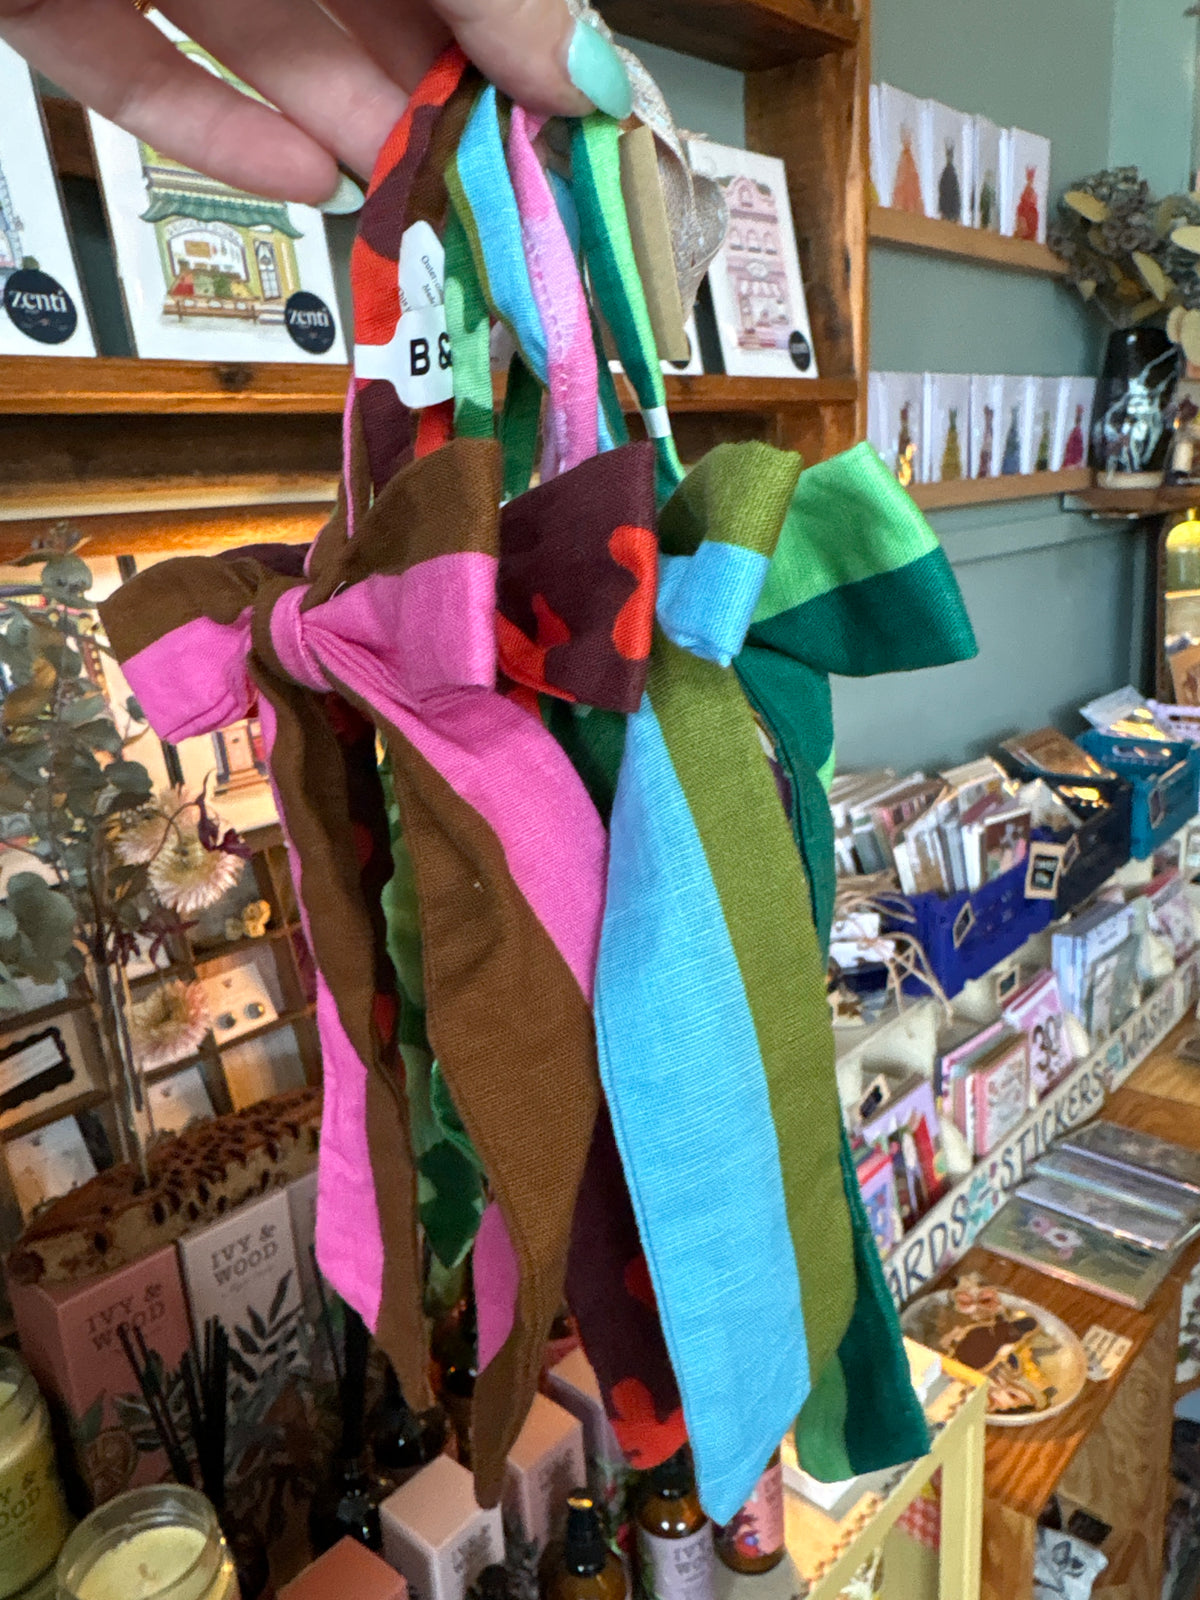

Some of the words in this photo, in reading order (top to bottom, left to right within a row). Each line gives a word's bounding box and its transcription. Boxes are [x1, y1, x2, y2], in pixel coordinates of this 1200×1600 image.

[409, 338, 431, 376] B
[438, 332, 452, 370] &
[888, 1194, 968, 1302] ARDS
[1000, 1059, 1103, 1191] STICKERS
[210, 1234, 251, 1271] IVY
[259, 1223, 278, 1243] &
[213, 1241, 279, 1287] WOOD
[86, 1295, 134, 1334] IVY
